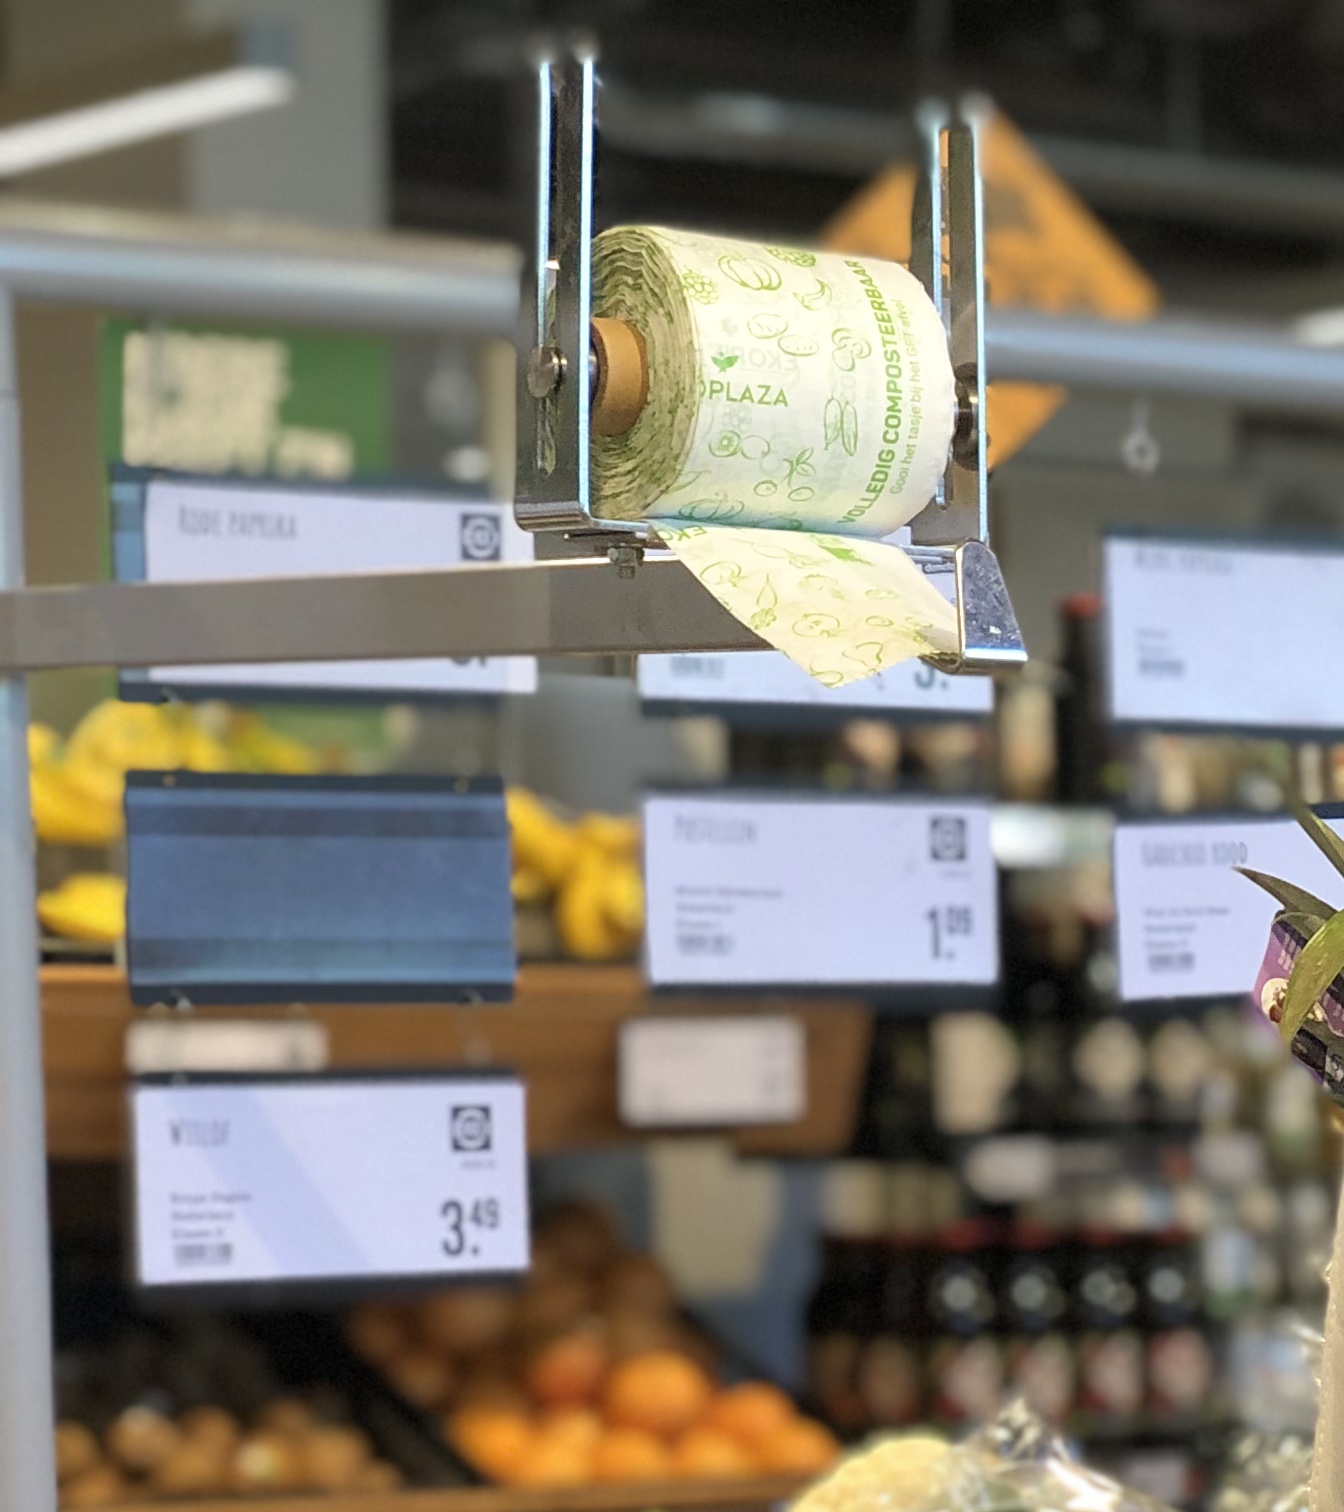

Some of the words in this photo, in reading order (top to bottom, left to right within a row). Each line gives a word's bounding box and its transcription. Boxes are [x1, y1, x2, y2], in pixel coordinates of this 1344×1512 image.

[844, 260, 904, 445] COMPOSTEERBAAR
[908, 360, 921, 382] het
[910, 384, 924, 403] bij
[907, 405, 924, 440] tasje
[901, 443, 917, 465] het
[838, 449, 896, 524] VOLLEDIG
